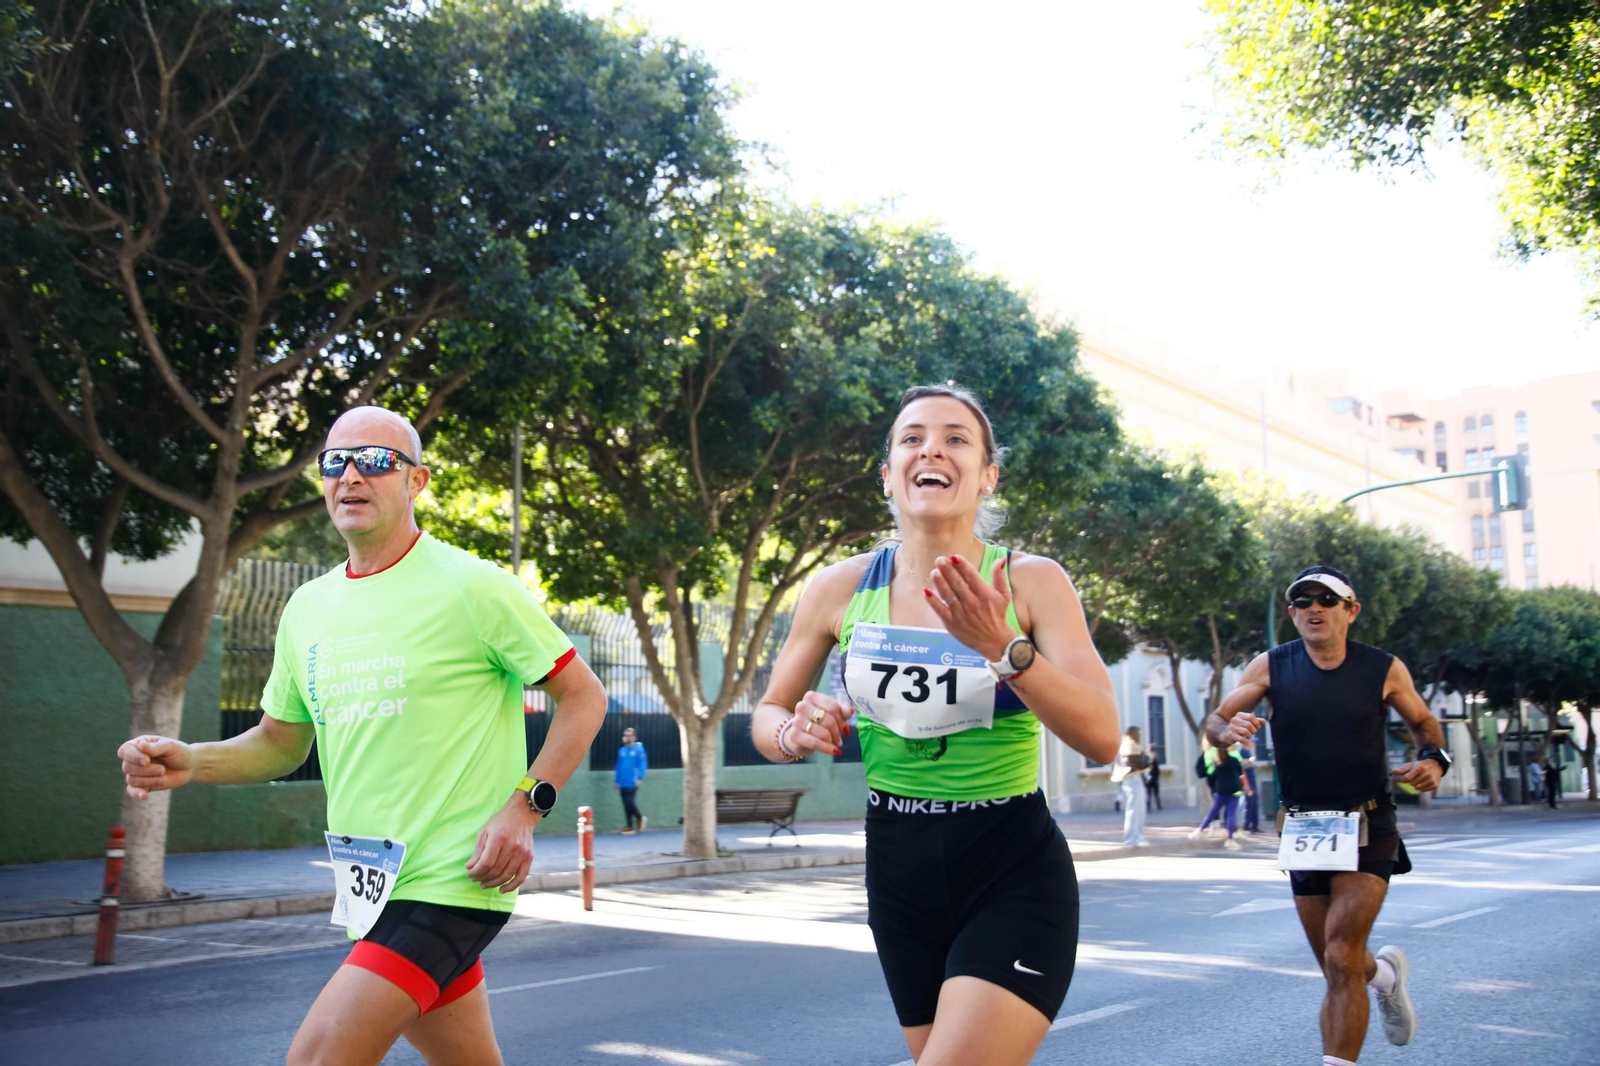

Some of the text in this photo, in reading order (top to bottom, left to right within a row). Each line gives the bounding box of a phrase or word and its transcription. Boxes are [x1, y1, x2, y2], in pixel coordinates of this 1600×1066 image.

[855, 640, 929, 654] contra el cáncer
[318, 653, 406, 679] En marcha
[319, 669, 406, 699] contra el
[871, 662, 957, 705] 731
[324, 697, 408, 724] cáncer
[888, 796, 947, 814] NIKE
[1295, 833, 1337, 852] 571
[350, 865, 386, 904] 359
